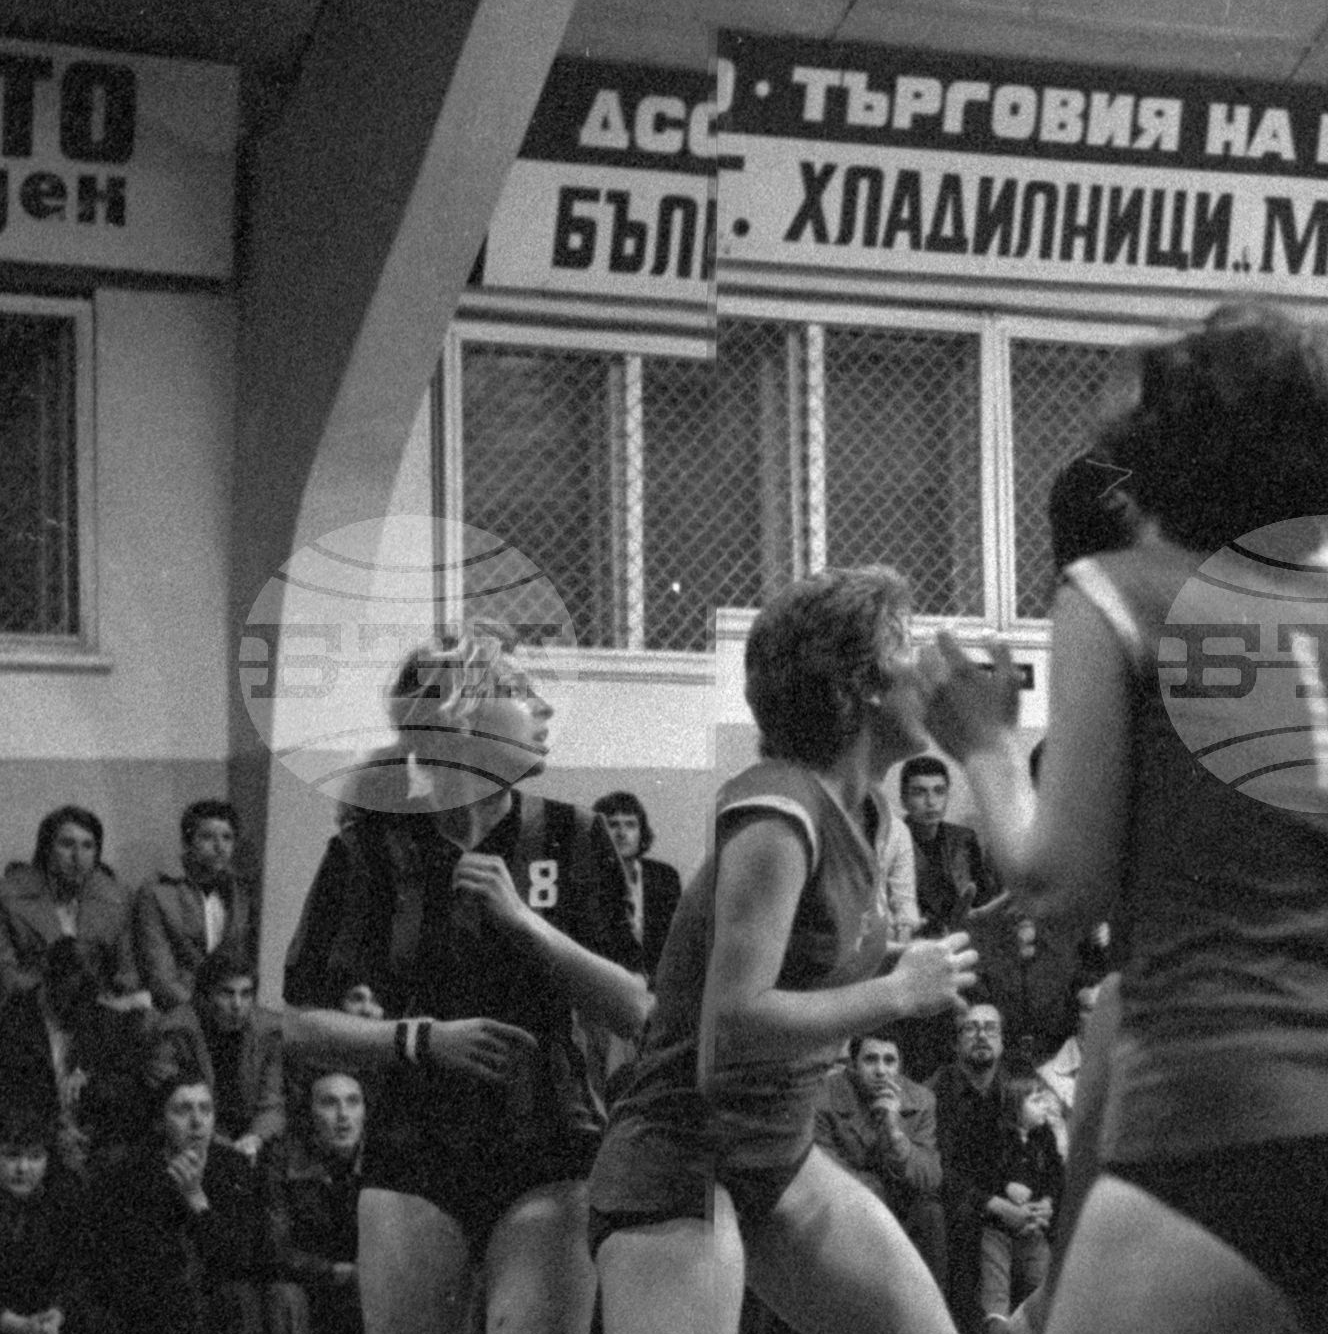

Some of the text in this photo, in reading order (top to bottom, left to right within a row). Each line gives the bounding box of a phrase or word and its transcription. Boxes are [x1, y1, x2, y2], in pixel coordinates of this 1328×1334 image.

[792, 66, 1183, 152] ТЪРГОВИЯ
[1204, 102, 1297, 161] НА
[0, 170, 127, 233] ен
[783, 161, 1233, 271] ХЛАДИЛНИЦИ
[529, 859, 558, 908] 8
